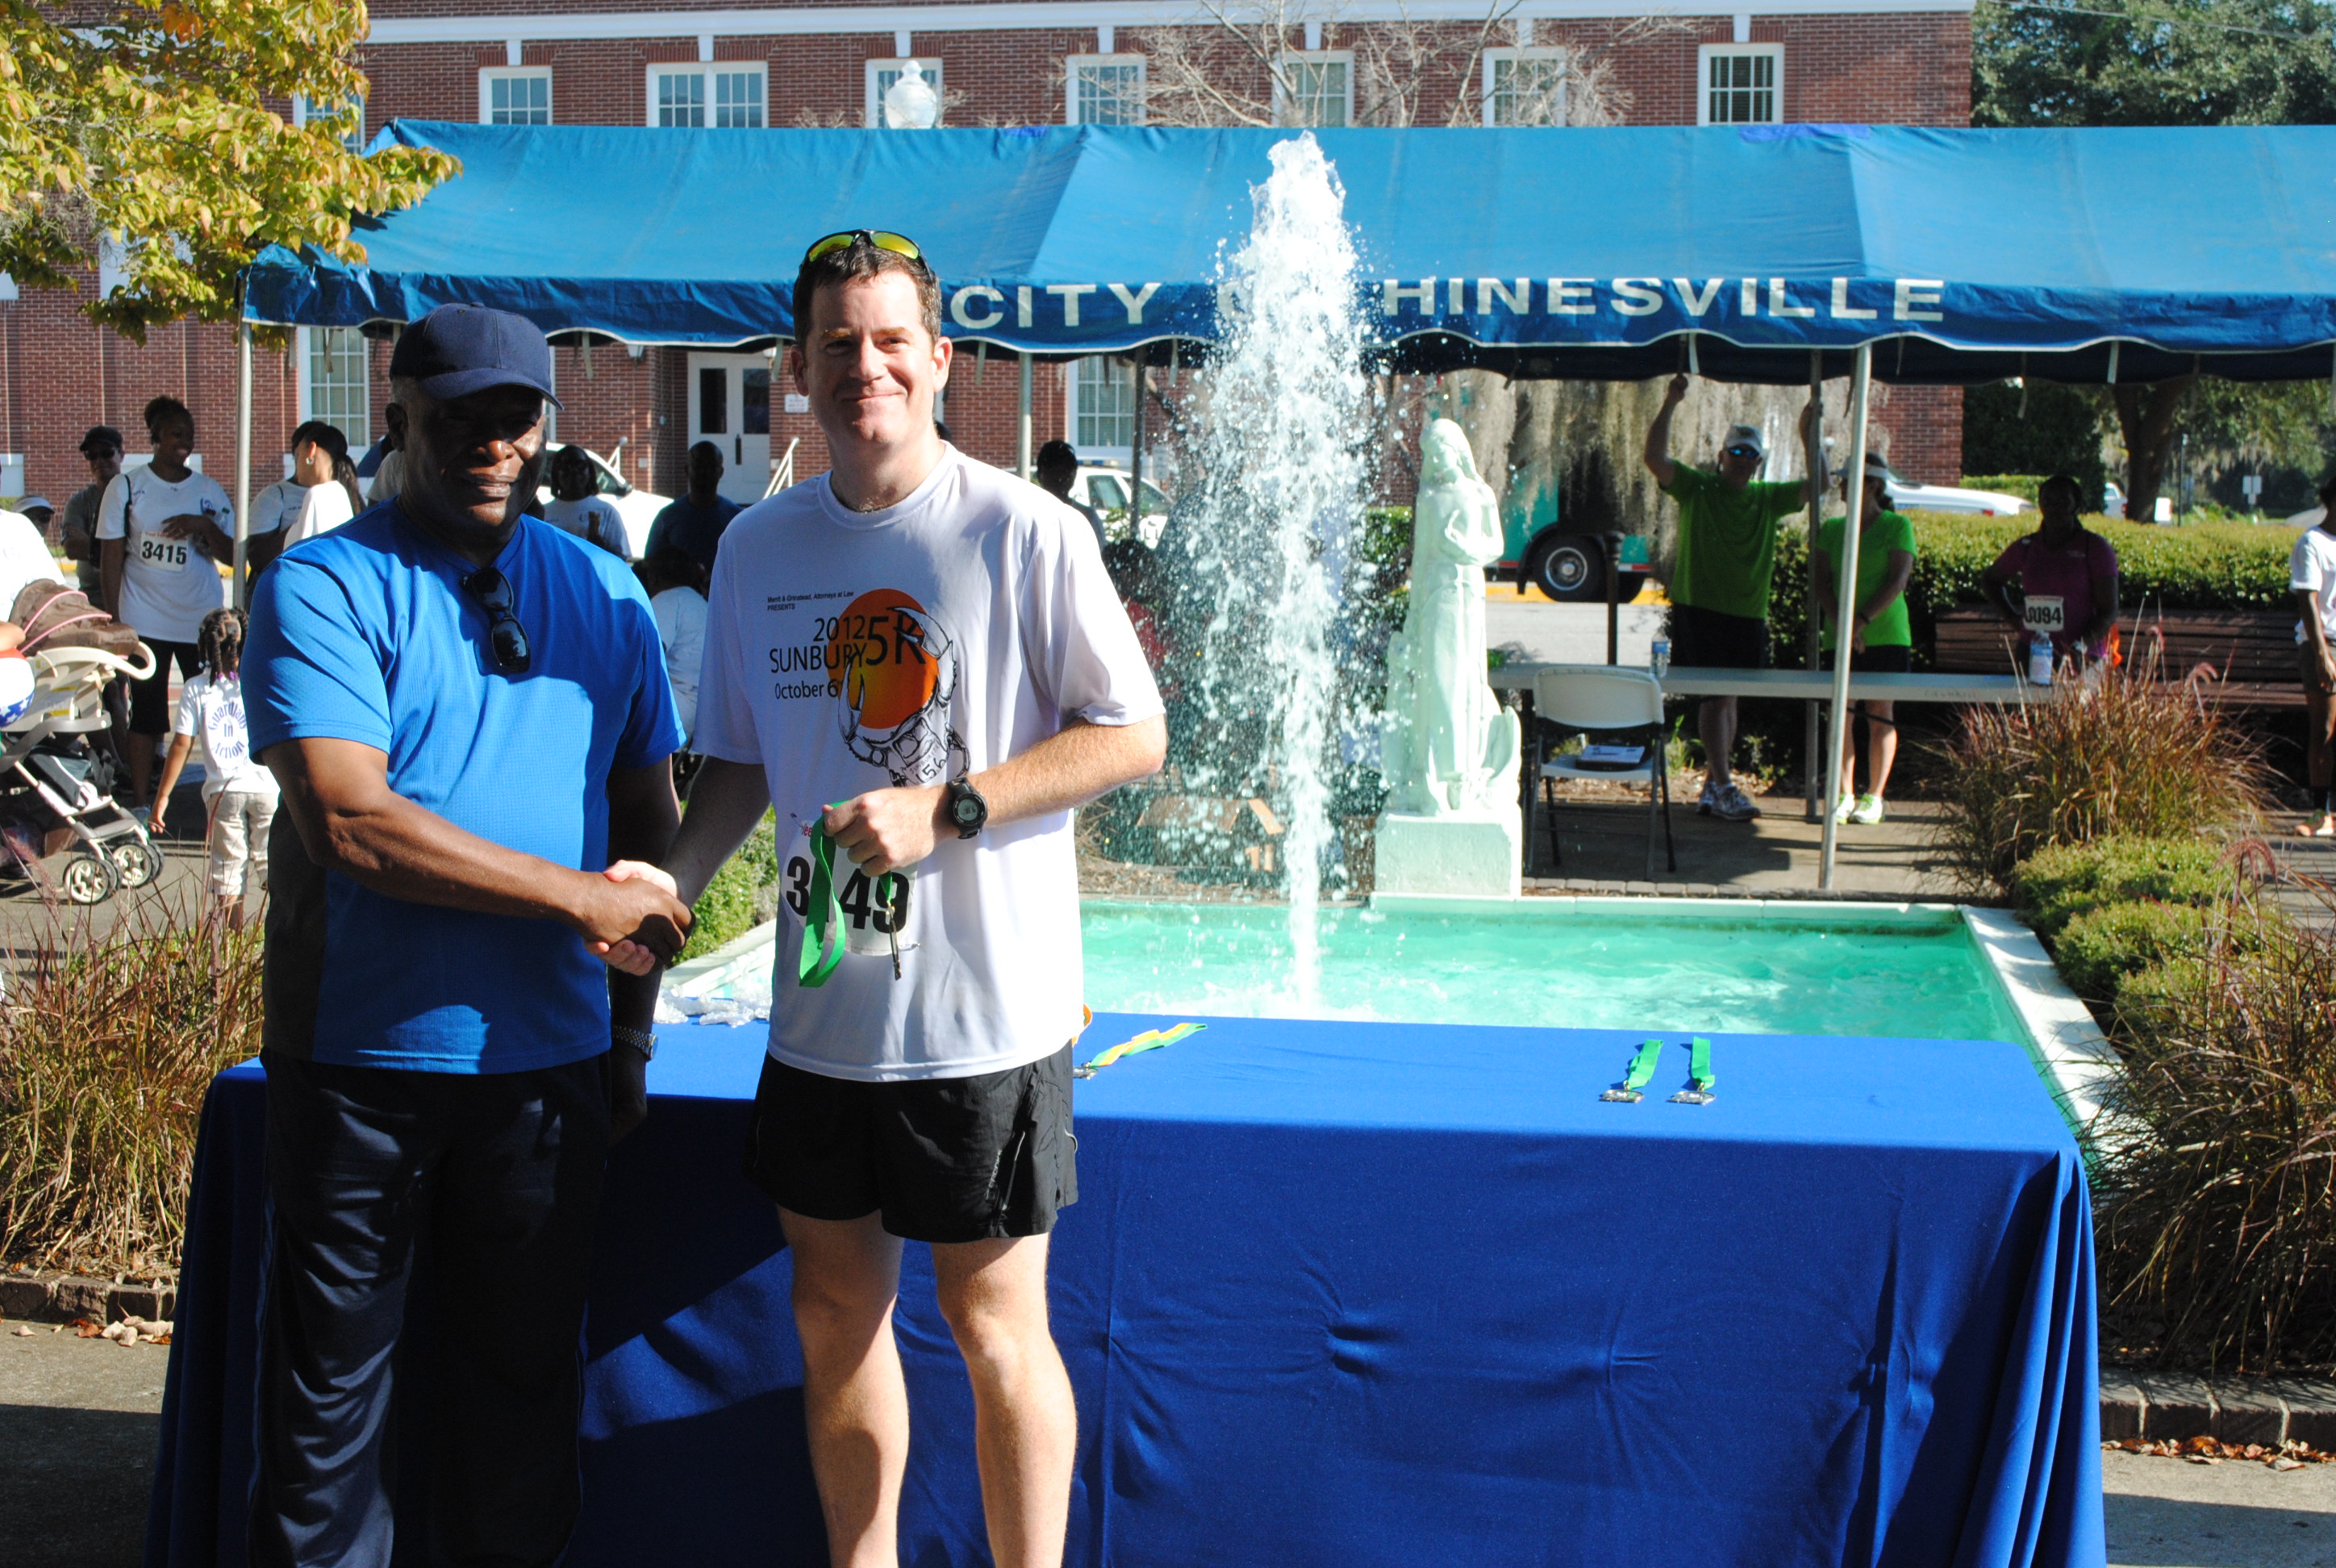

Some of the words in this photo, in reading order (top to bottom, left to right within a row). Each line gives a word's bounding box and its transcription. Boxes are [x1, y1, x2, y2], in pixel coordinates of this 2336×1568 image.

[949, 282, 1162, 330] CITY
[1383, 277, 1944, 321] HINESVILLE
[142, 540, 187, 565] 3415
[770, 643, 868, 673] SUNBURY
[866, 611, 926, 666] 5K
[813, 615, 866, 642] 2012
[775, 680, 824, 699] October
[211, 740, 245, 759] Action
[786, 856, 910, 934] 349
